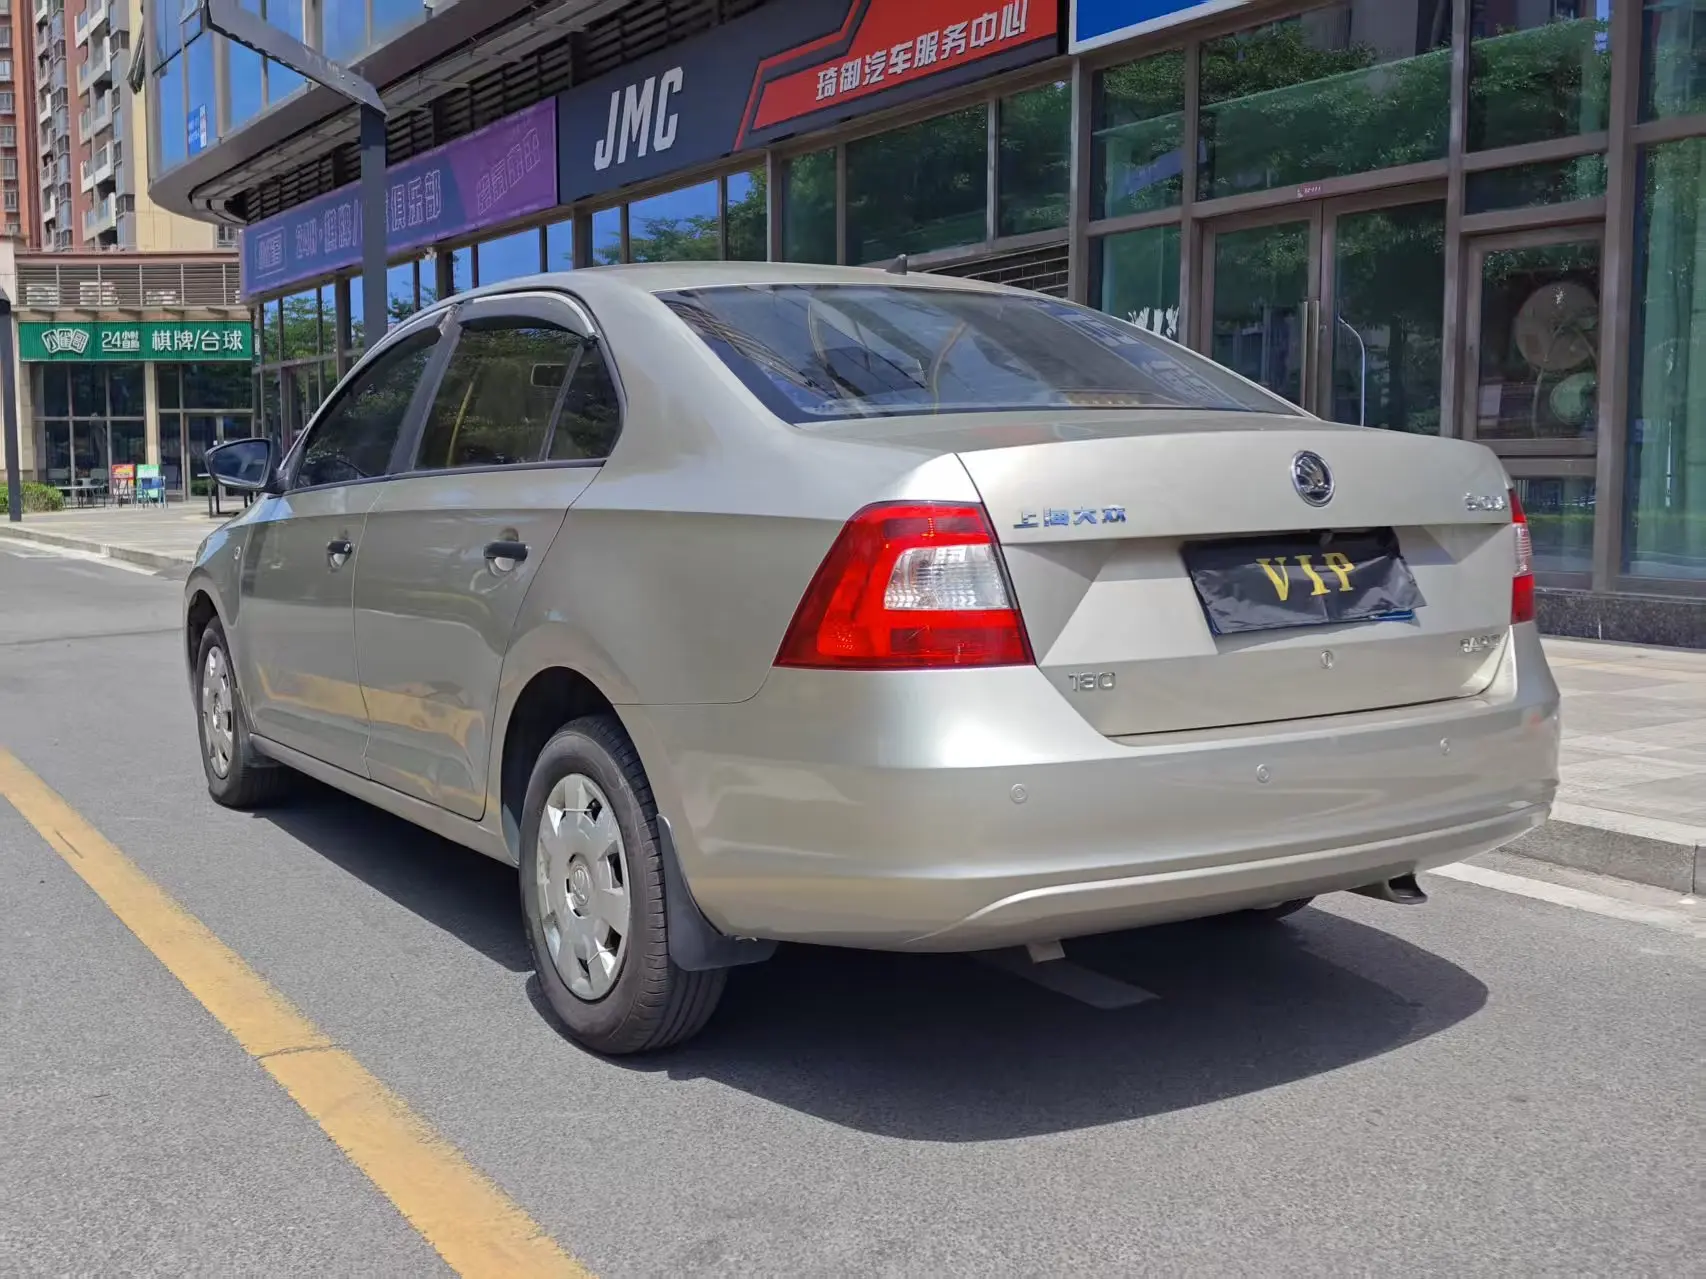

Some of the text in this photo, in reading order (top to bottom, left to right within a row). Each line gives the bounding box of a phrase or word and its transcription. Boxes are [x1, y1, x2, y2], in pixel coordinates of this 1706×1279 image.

[594, 67, 684, 171] JMC
[152, 330, 244, 351] 棋牌/台球
[1013, 506, 1127, 529] 上海大众
[1256, 551, 1356, 602] VIP
